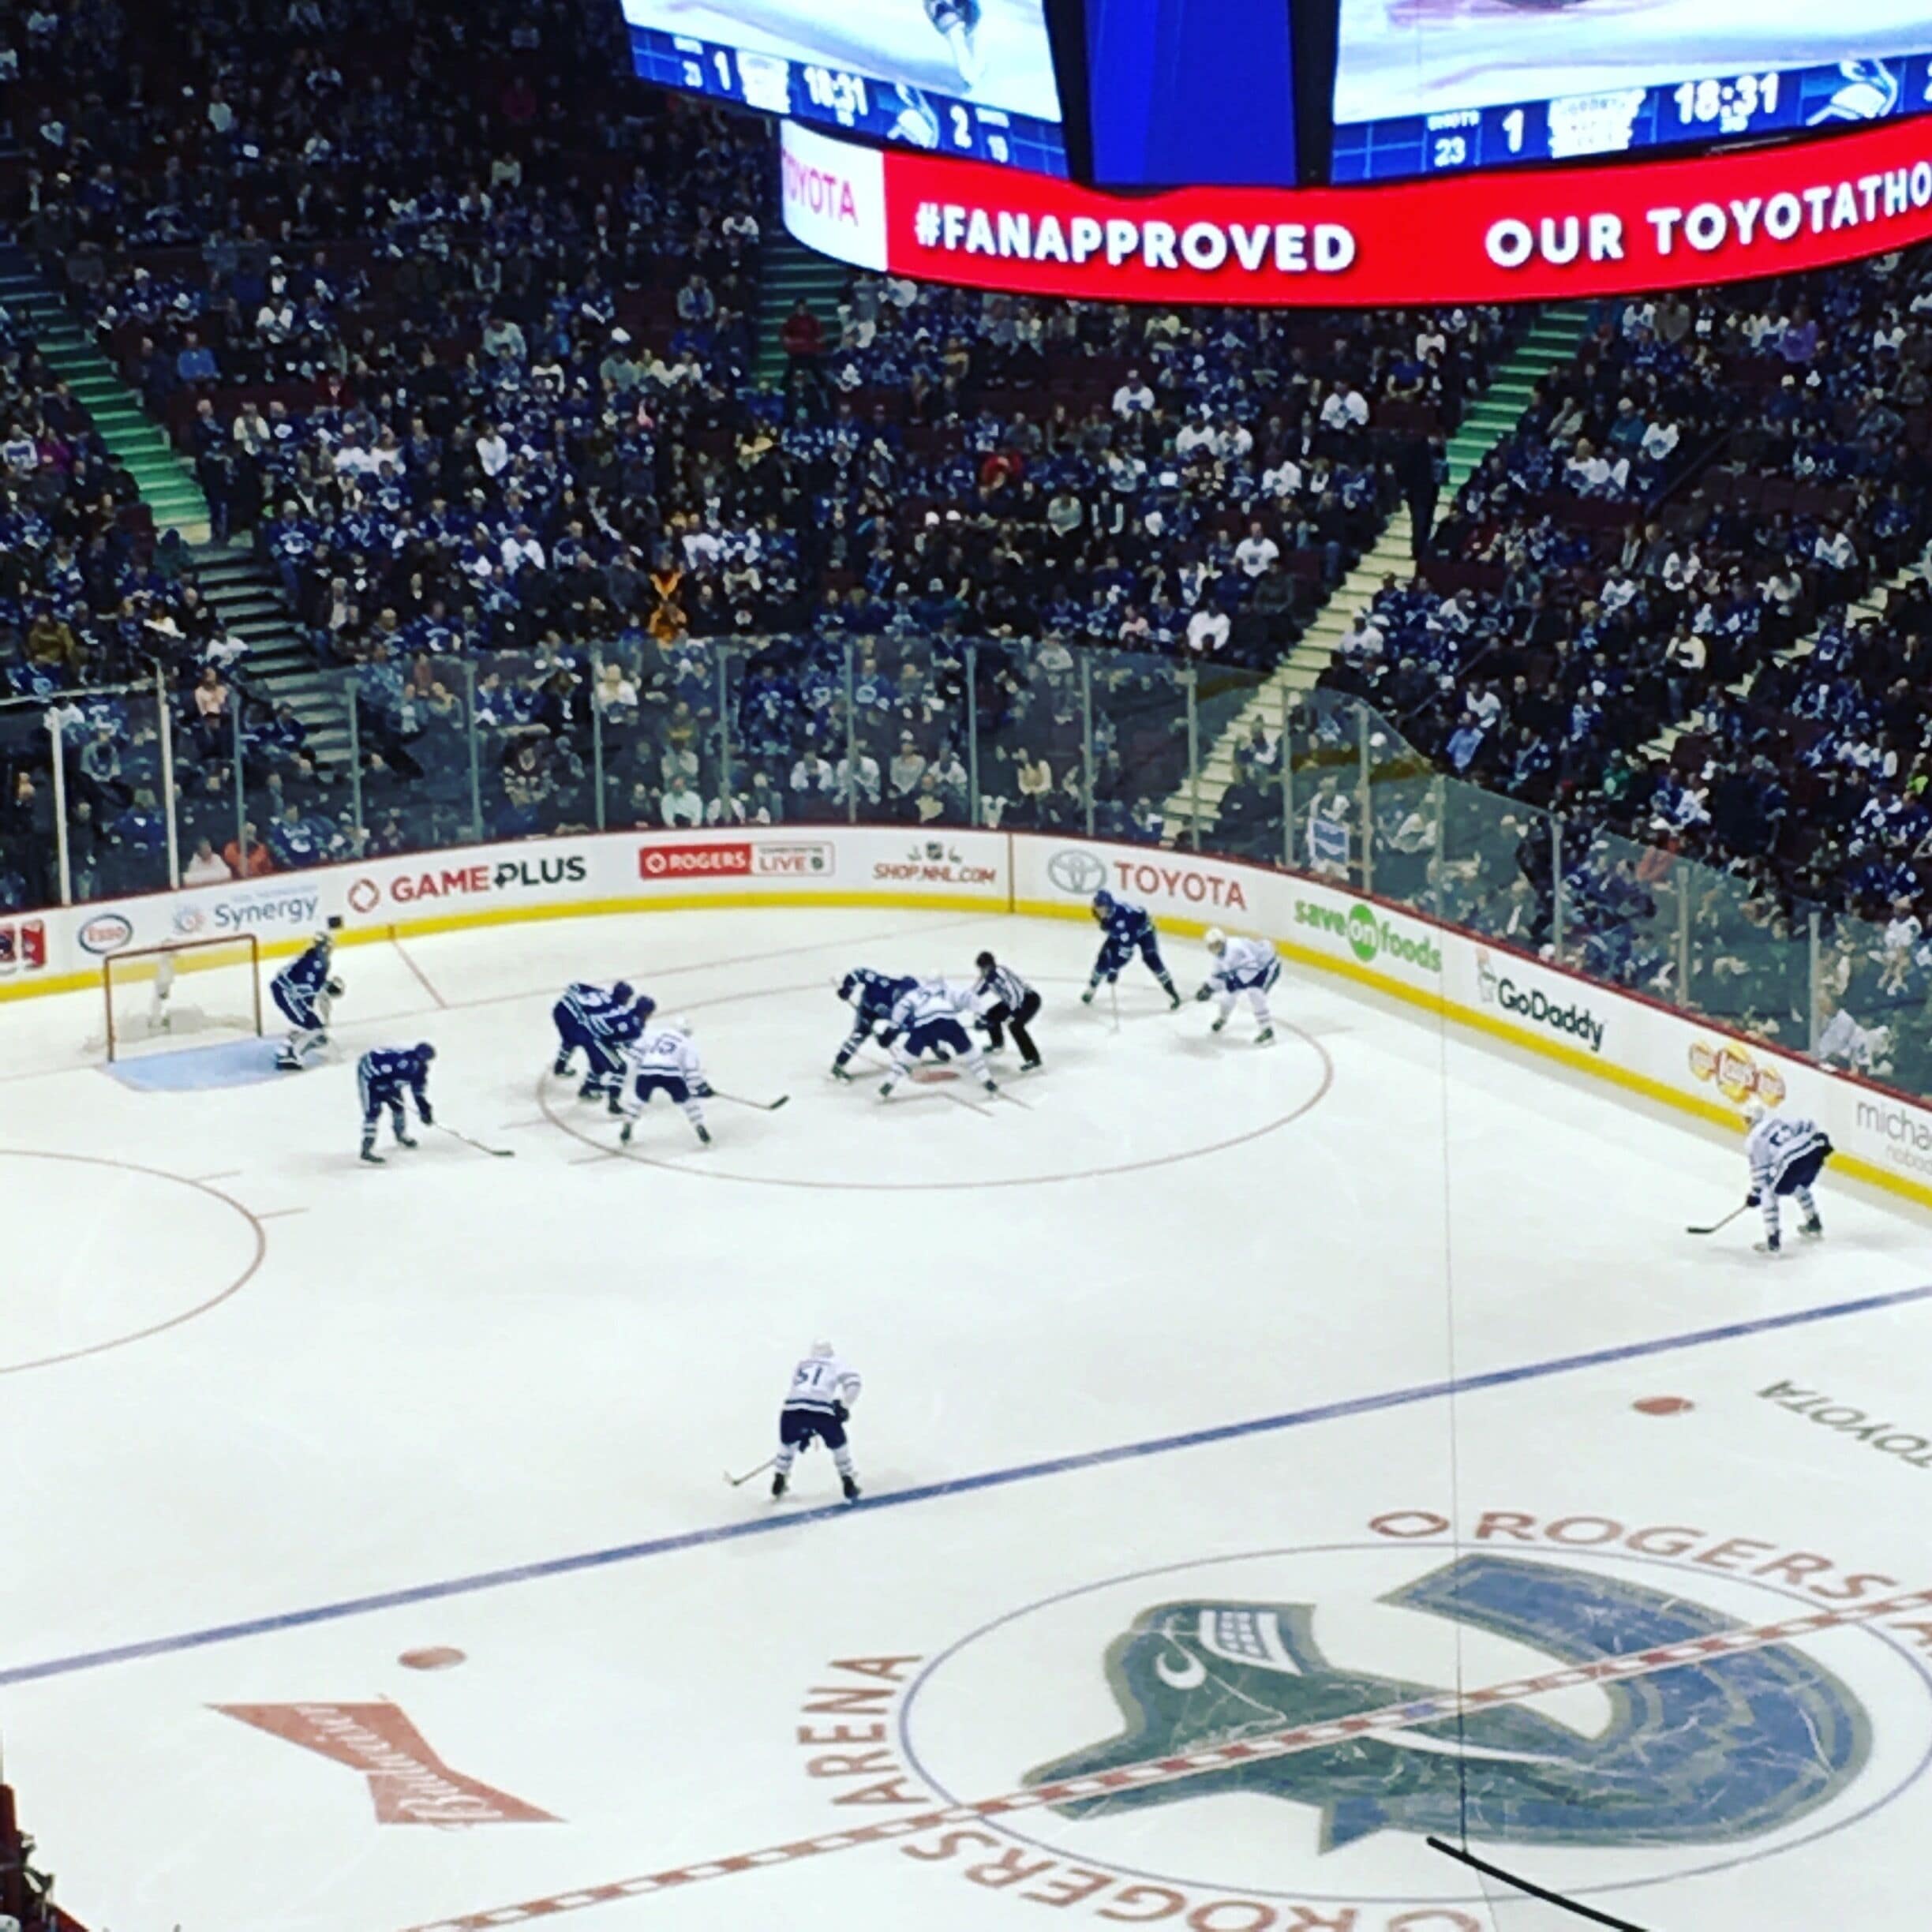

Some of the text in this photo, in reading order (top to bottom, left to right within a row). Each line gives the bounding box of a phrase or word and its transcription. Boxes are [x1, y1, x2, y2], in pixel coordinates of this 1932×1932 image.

[1674, 71, 1779, 124] 18:31
[950, 105, 972, 148] 2
[1434, 137, 1466, 167] 23
[1503, 109, 1524, 153] 1
[914, 202, 1356, 271] #FANAPPROVED
[1485, 213, 1624, 268] OUR
[669, 852, 747, 871] ROGERS
[760, 856, 806, 871] LIVE
[1113, 859, 1248, 911] TOYOTA
[215, 897, 318, 931] Synergy
[1294, 899, 1443, 973] save on foods
[1497, 979, 1604, 1051] GoDaddy
[1755, 1380, 1932, 1468] TOYOTA
[1474, 1511, 1898, 1599] ROGERS
[797, 1653, 932, 1809] ARENA
[900, 1828, 1364, 1932] ROGERS
